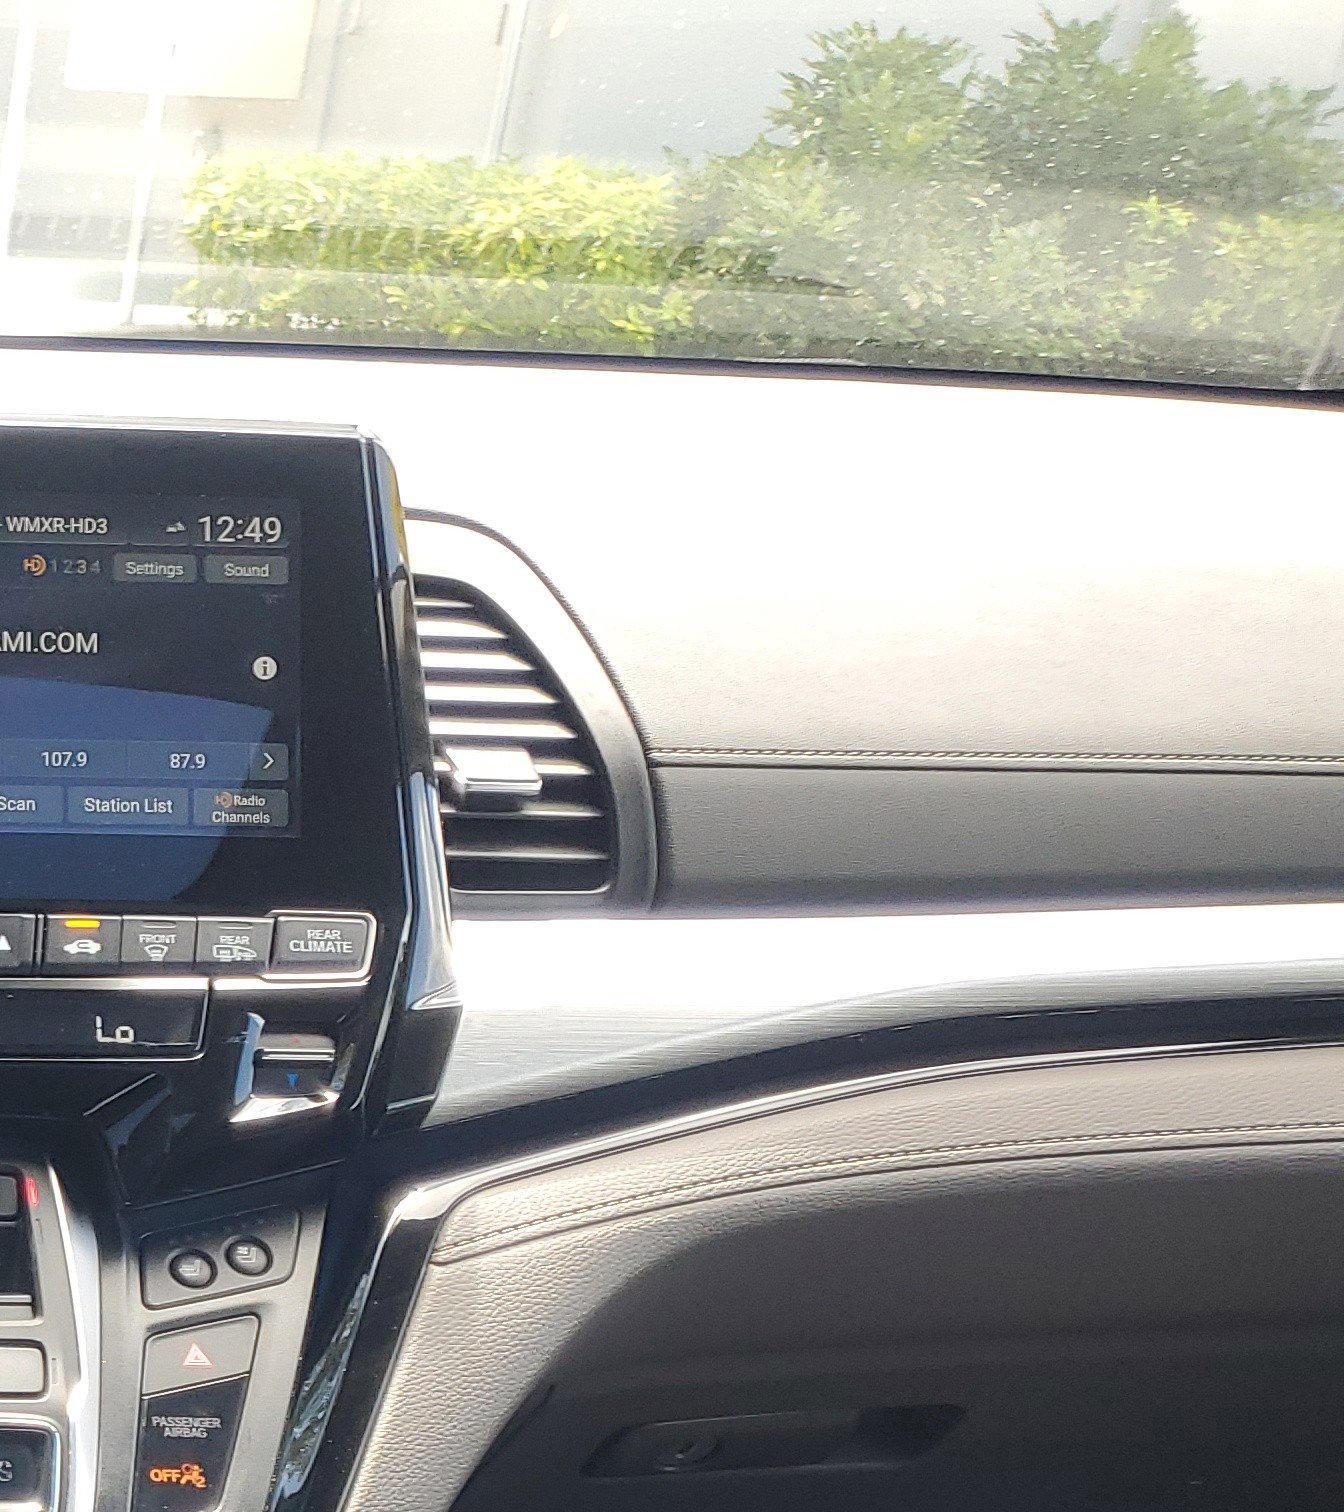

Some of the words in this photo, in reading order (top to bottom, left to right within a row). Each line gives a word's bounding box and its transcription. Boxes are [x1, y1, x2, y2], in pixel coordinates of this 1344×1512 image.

[6, 517, 109, 534] WMXR-HD3
[198, 516, 283, 543] 12:49
[125, 561, 184, 578] Settings
[224, 563, 269, 577] Sound
[41, 750, 88, 768] 107.9
[169, 752, 206, 769] 87.9
[83, 797, 141, 814] Station
[144, 798, 173, 814] List
[233, 794, 266, 807] Radio
[212, 811, 271, 825] Channels
[139, 934, 177, 946] FRONT
[219, 935, 250, 945] REAR
[307, 929, 341, 940] REAR
[289, 939, 354, 955] CLIMATE
[151, 1416, 222, 1429] PASSENGER
[164, 1427, 209, 1439] AIRBAG
[149, 1468, 181, 1482] OFF
